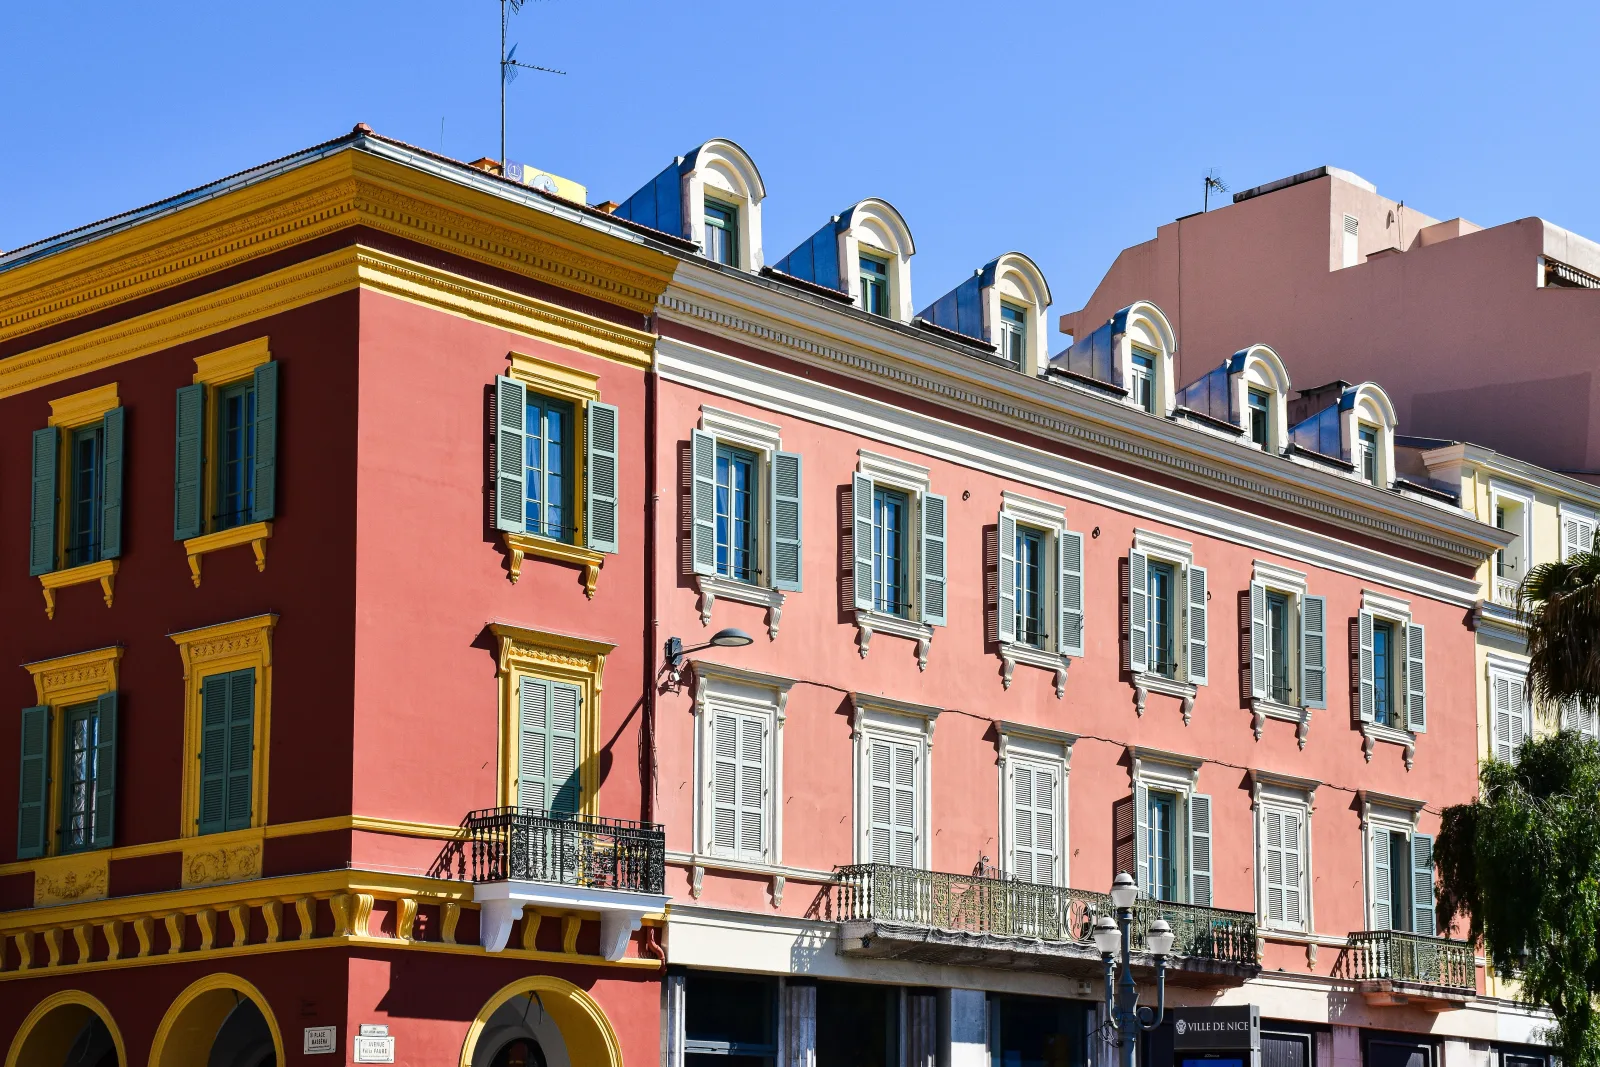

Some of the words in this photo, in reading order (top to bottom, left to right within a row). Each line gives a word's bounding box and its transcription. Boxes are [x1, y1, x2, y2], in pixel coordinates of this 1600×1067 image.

[1187, 1022, 1211, 1031] VILLE
[1213, 1022, 1225, 1031] DE
[1227, 1021, 1249, 1031] NICE
